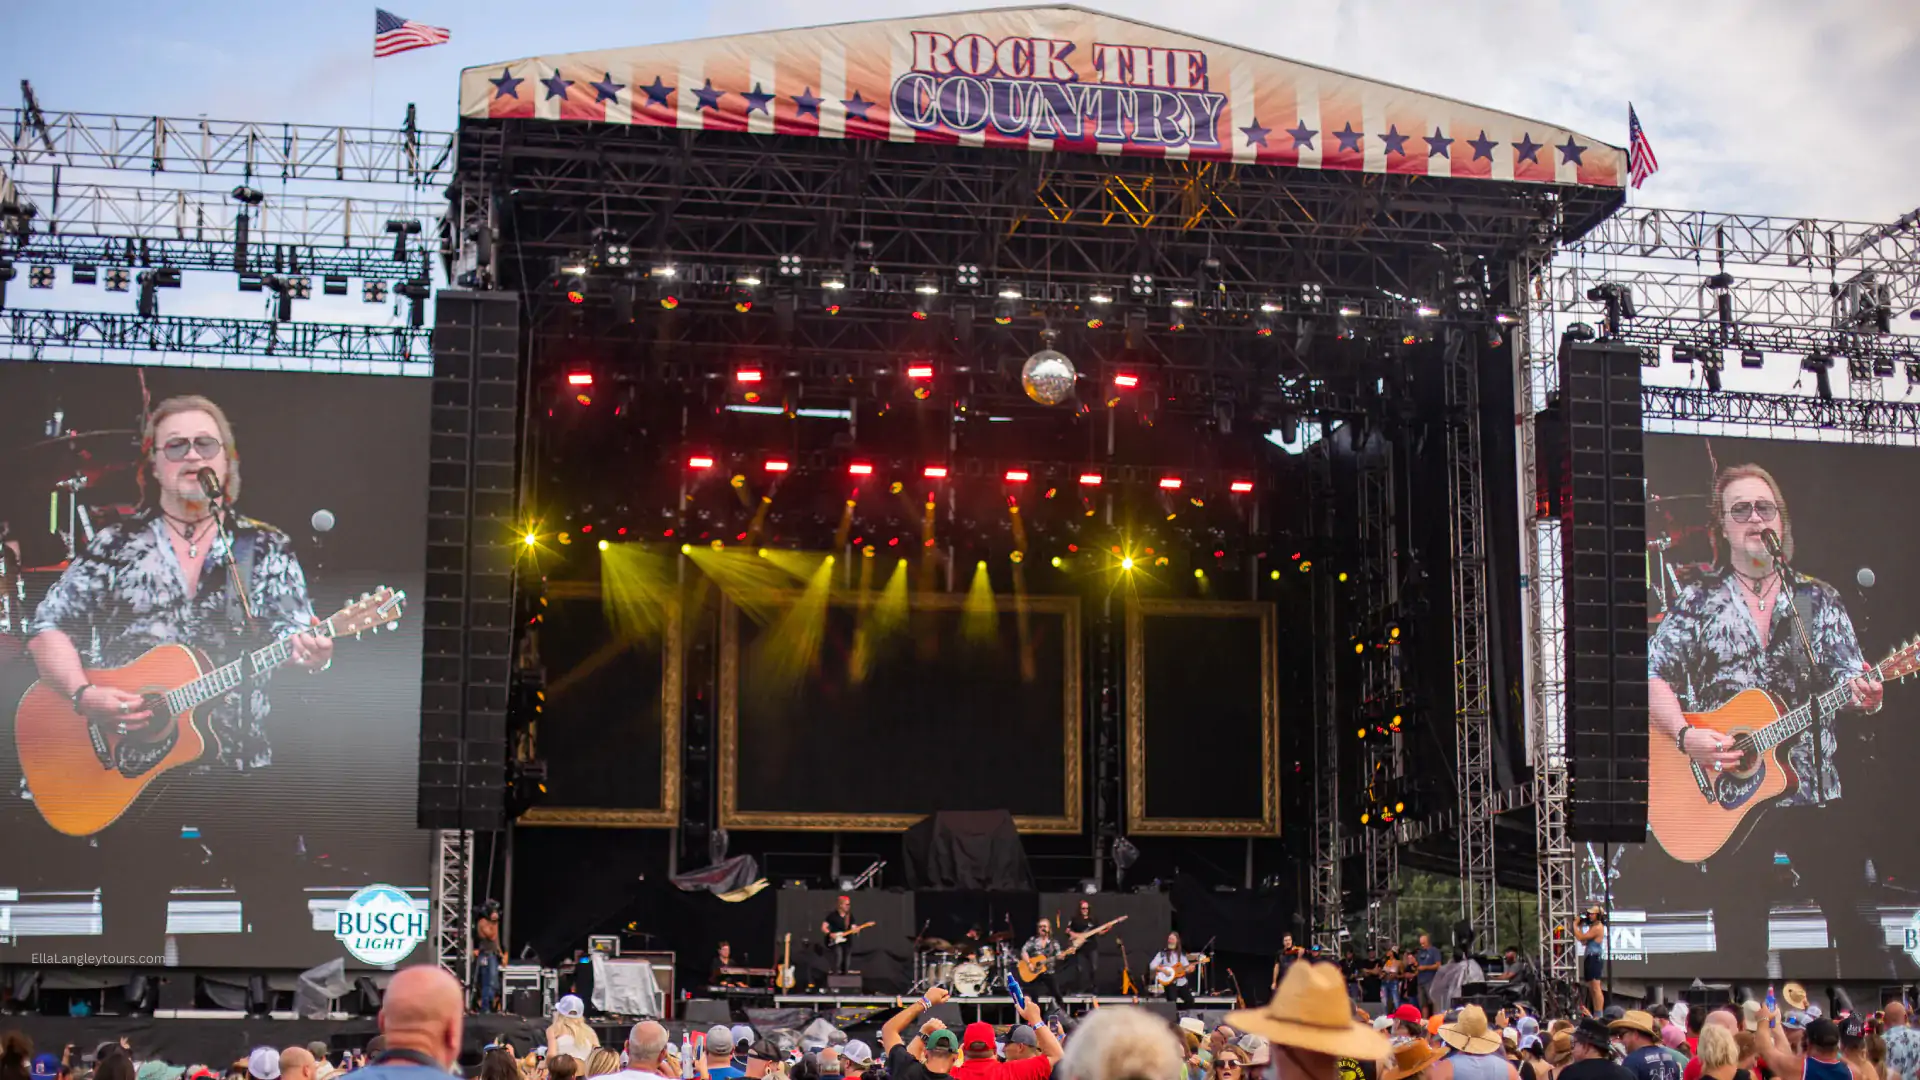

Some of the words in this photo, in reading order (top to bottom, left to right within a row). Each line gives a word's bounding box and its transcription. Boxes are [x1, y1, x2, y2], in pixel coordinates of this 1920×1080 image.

[910, 31, 1078, 81] ROCK
[1092, 42, 1208, 90] THE
[891, 72, 1228, 148] COUNTRY
[338, 911, 422, 937] BUSCH
[355, 937, 405, 950] LIGHT
[1615, 953, 1642, 961] POUCHES
